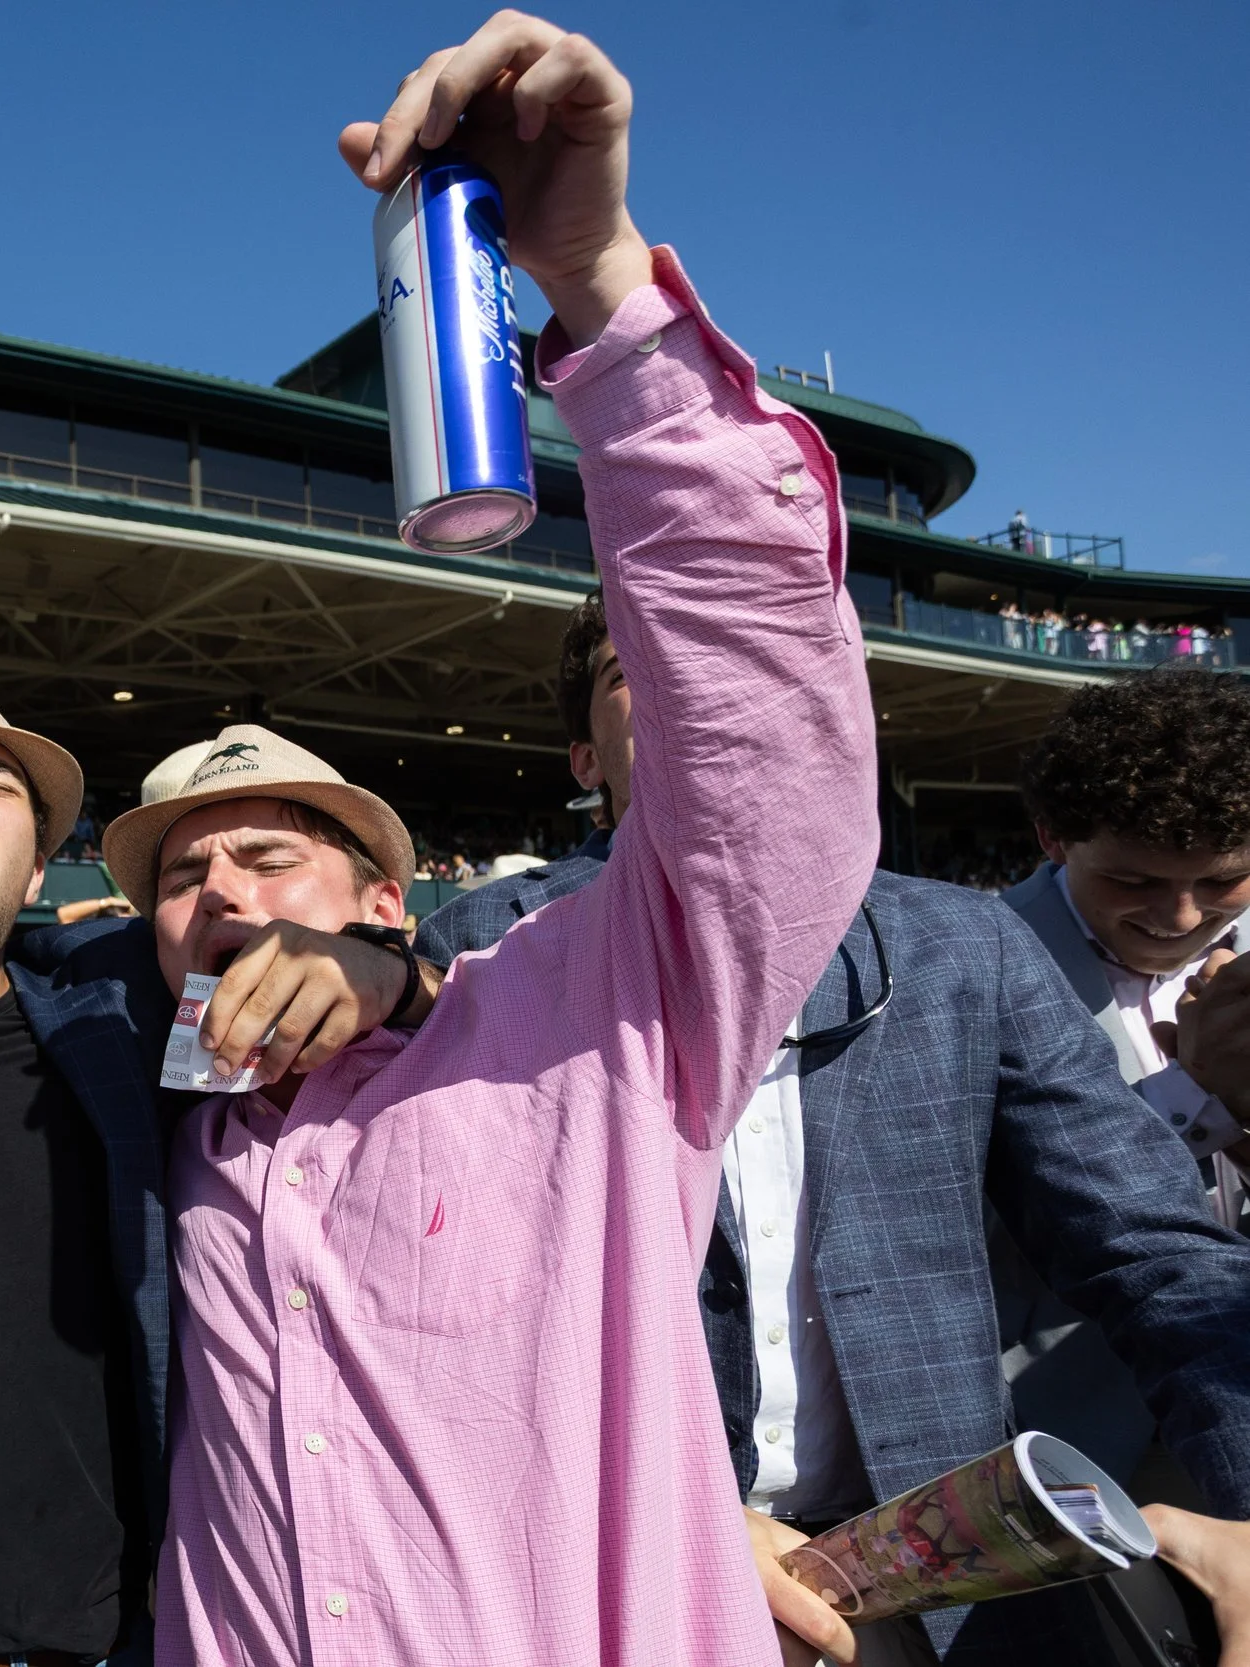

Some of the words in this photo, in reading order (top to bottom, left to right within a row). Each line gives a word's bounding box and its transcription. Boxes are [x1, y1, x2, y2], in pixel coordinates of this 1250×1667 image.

[466, 237, 506, 362] Michelob
[184, 980, 210, 992] KEEN
[162, 1069, 190, 1082] KEEN
